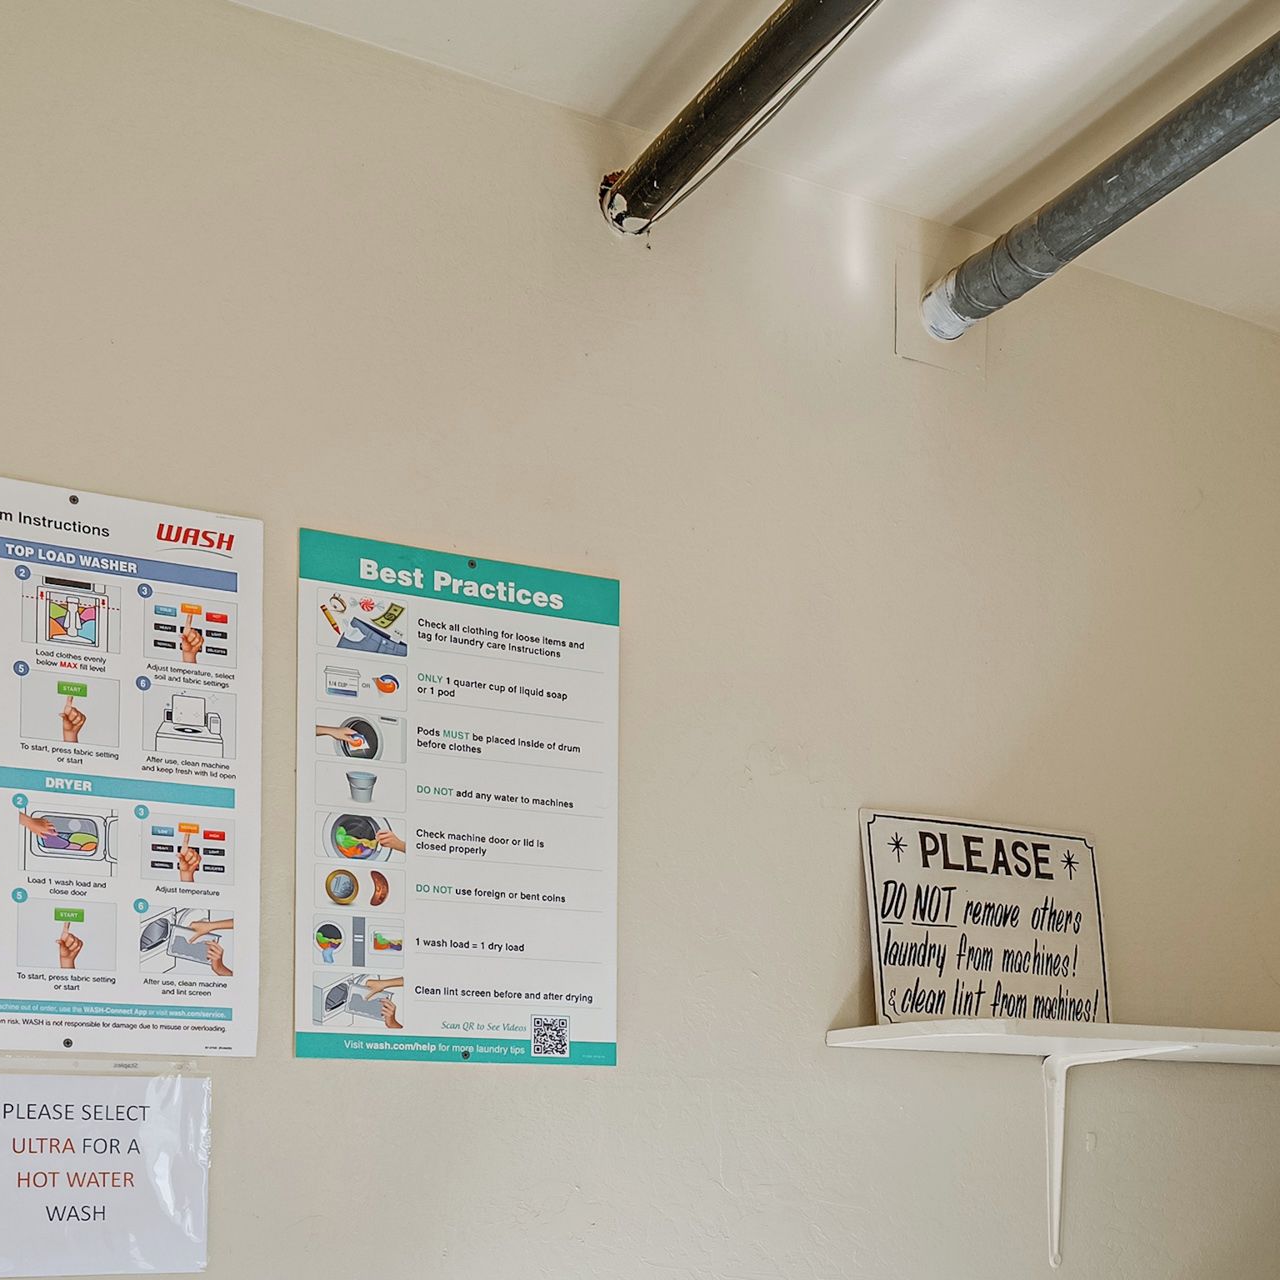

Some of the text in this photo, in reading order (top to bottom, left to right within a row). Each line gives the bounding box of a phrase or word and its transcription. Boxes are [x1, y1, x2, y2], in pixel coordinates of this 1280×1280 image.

[18, 511, 110, 538] Instructions
[156, 523, 234, 551] WASH
[5, 543, 139, 574] TOP LOAD WASHER
[358, 557, 564, 610] Best Practices
[417, 618, 585, 650] Check all clothing for loose items and
[417, 630, 561, 658] tag for laundry care instructions
[61, 684, 83, 694] START
[417, 726, 581, 753] Pods MUST be placed inside of drum
[45, 777, 92, 795] DRYER
[918, 830, 1055, 881] PLEASE
[415, 884, 431, 893] DO
[433, 885, 453, 894] NOT
[455, 888, 472, 896] use
[474, 888, 506, 900] foreign
[520, 891, 540, 901] bent
[541, 894, 566, 904] coins
[880, 880, 1082, 934] DO NOT remove others
[883, 928, 1078, 978] laundry from machines!
[888, 976, 1099, 1023] & clean lint from machines!
[343, 1039, 526, 1056] Visit wash.com/help for more laundry tips
[3, 1103, 151, 1122] PLEASE SELECT
[12, 1137, 141, 1155] ULTRA FOR A
[17, 1171, 135, 1188] HOT WATER
[45, 1205, 106, 1222] WASH
